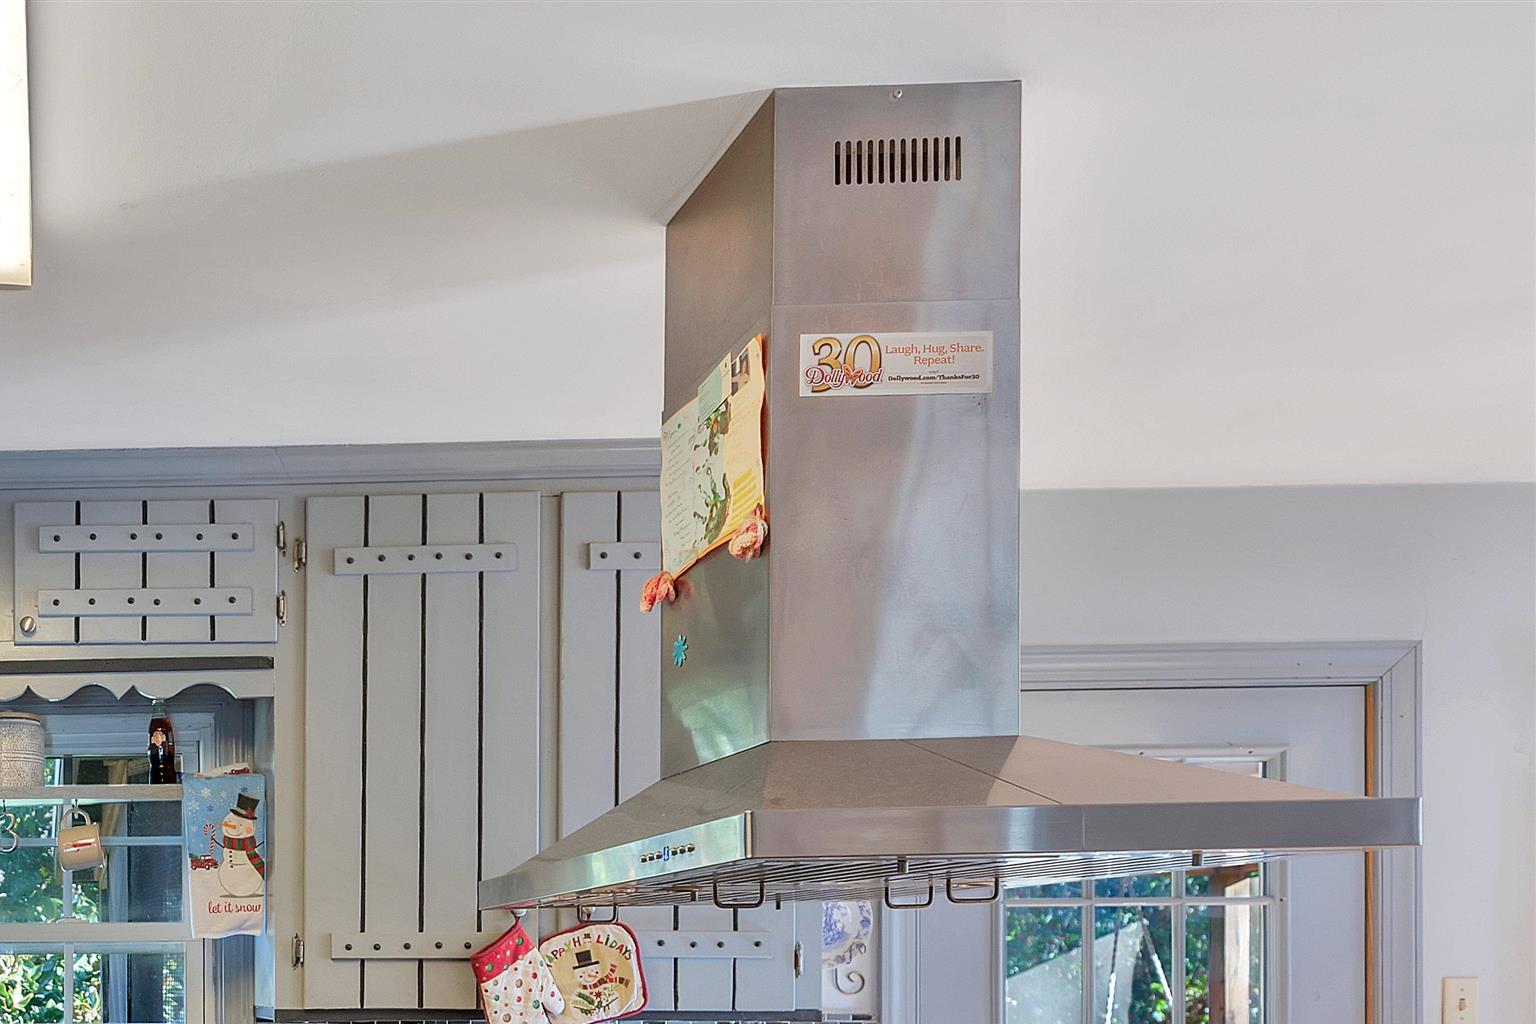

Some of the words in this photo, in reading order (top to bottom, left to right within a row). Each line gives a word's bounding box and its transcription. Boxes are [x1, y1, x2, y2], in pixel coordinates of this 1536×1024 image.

[885, 343, 921, 356] Laugh,
[923, 344, 948, 355] Hug,
[949, 342, 984, 353] Share.
[811, 335, 881, 392] 30
[914, 355, 955, 367] Repeat!
[208, 901, 222, 914] let
[224, 901, 233, 913] it
[235, 904, 261, 913] snow
